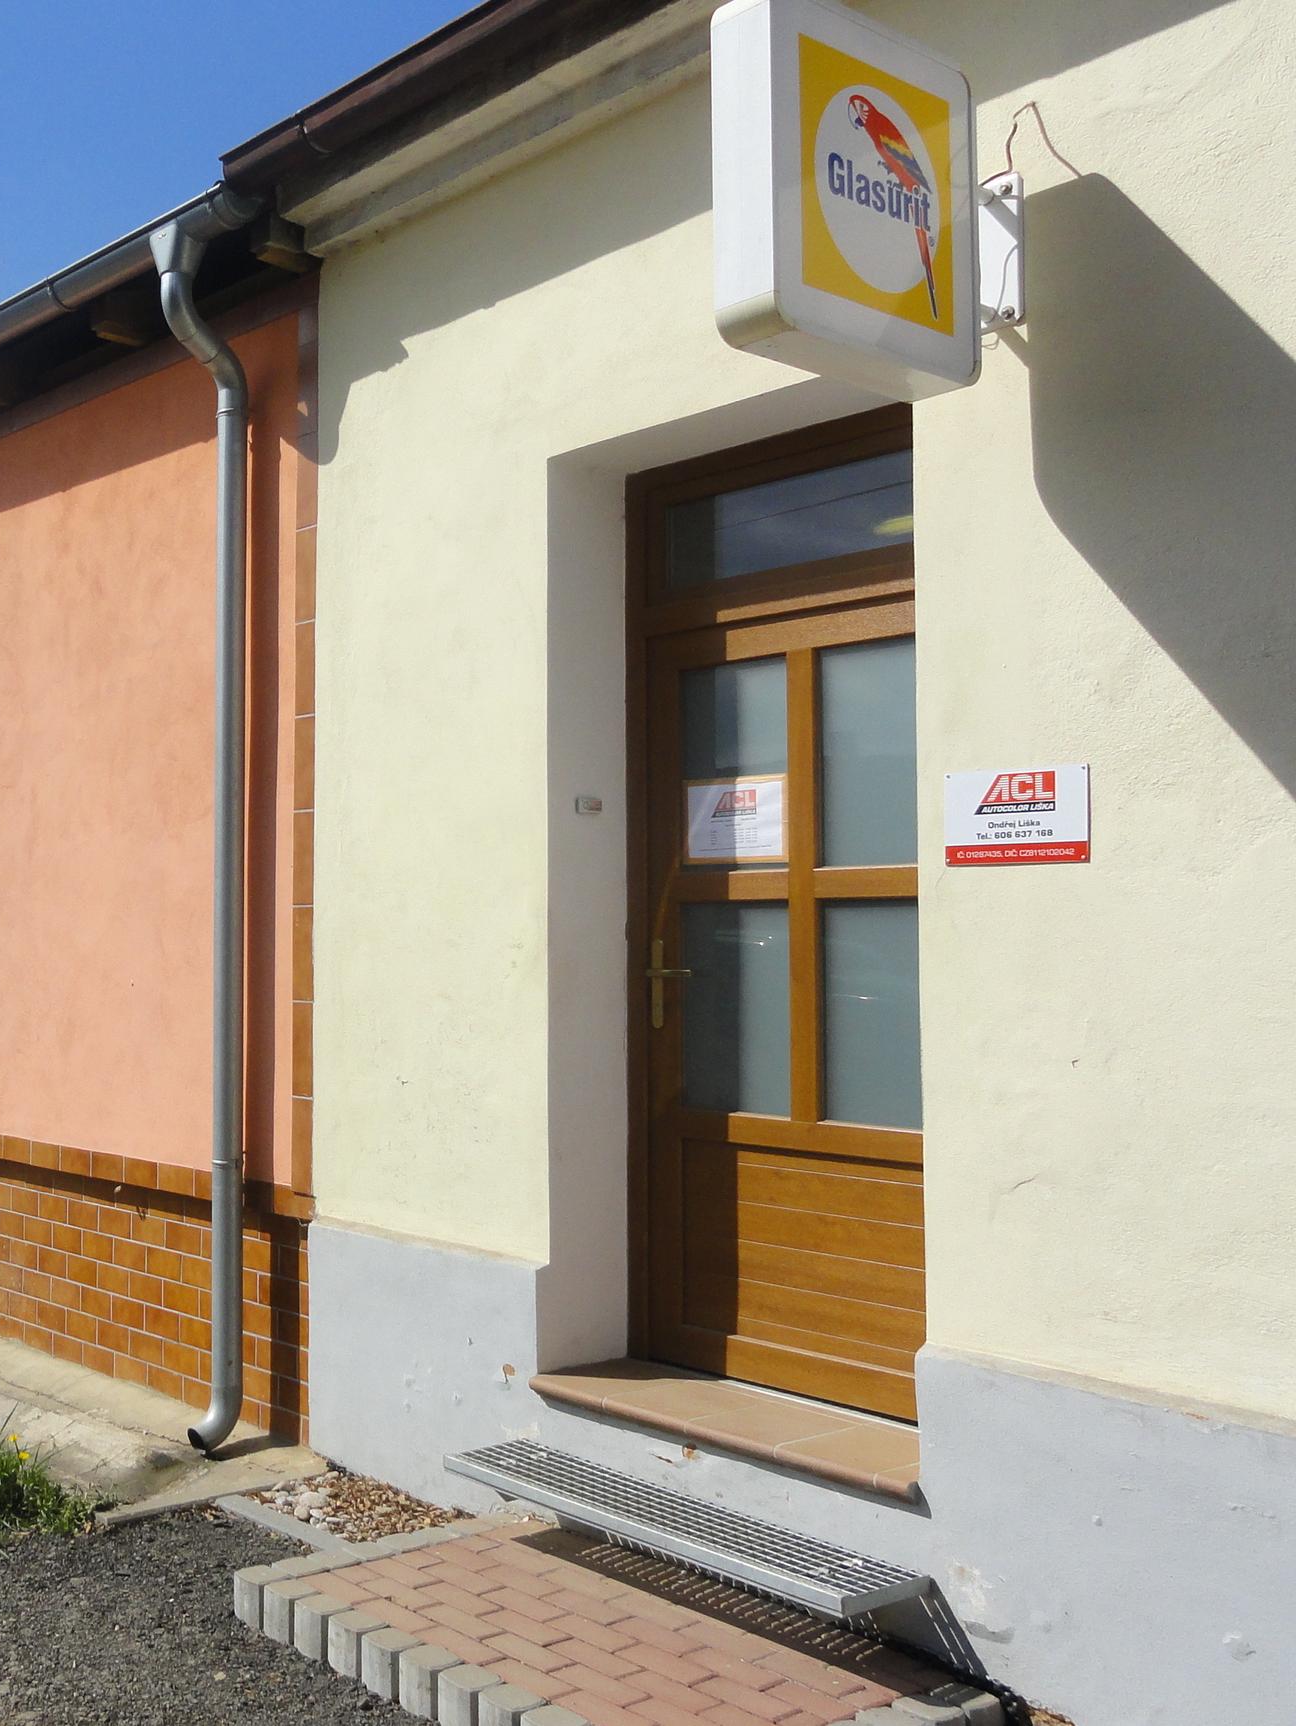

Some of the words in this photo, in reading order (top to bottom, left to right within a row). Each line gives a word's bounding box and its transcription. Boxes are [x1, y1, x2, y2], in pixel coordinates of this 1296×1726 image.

[828, 152, 930, 232] Glasurit
[987, 774, 1054, 802] ACL
[982, 804, 1029, 813] AUTOCOLOR
[988, 821, 1016, 829] Ondřej
[994, 831, 1012, 839] 606
[1015, 830, 1032, 838] 637
[1035, 829, 1054, 837] 168
